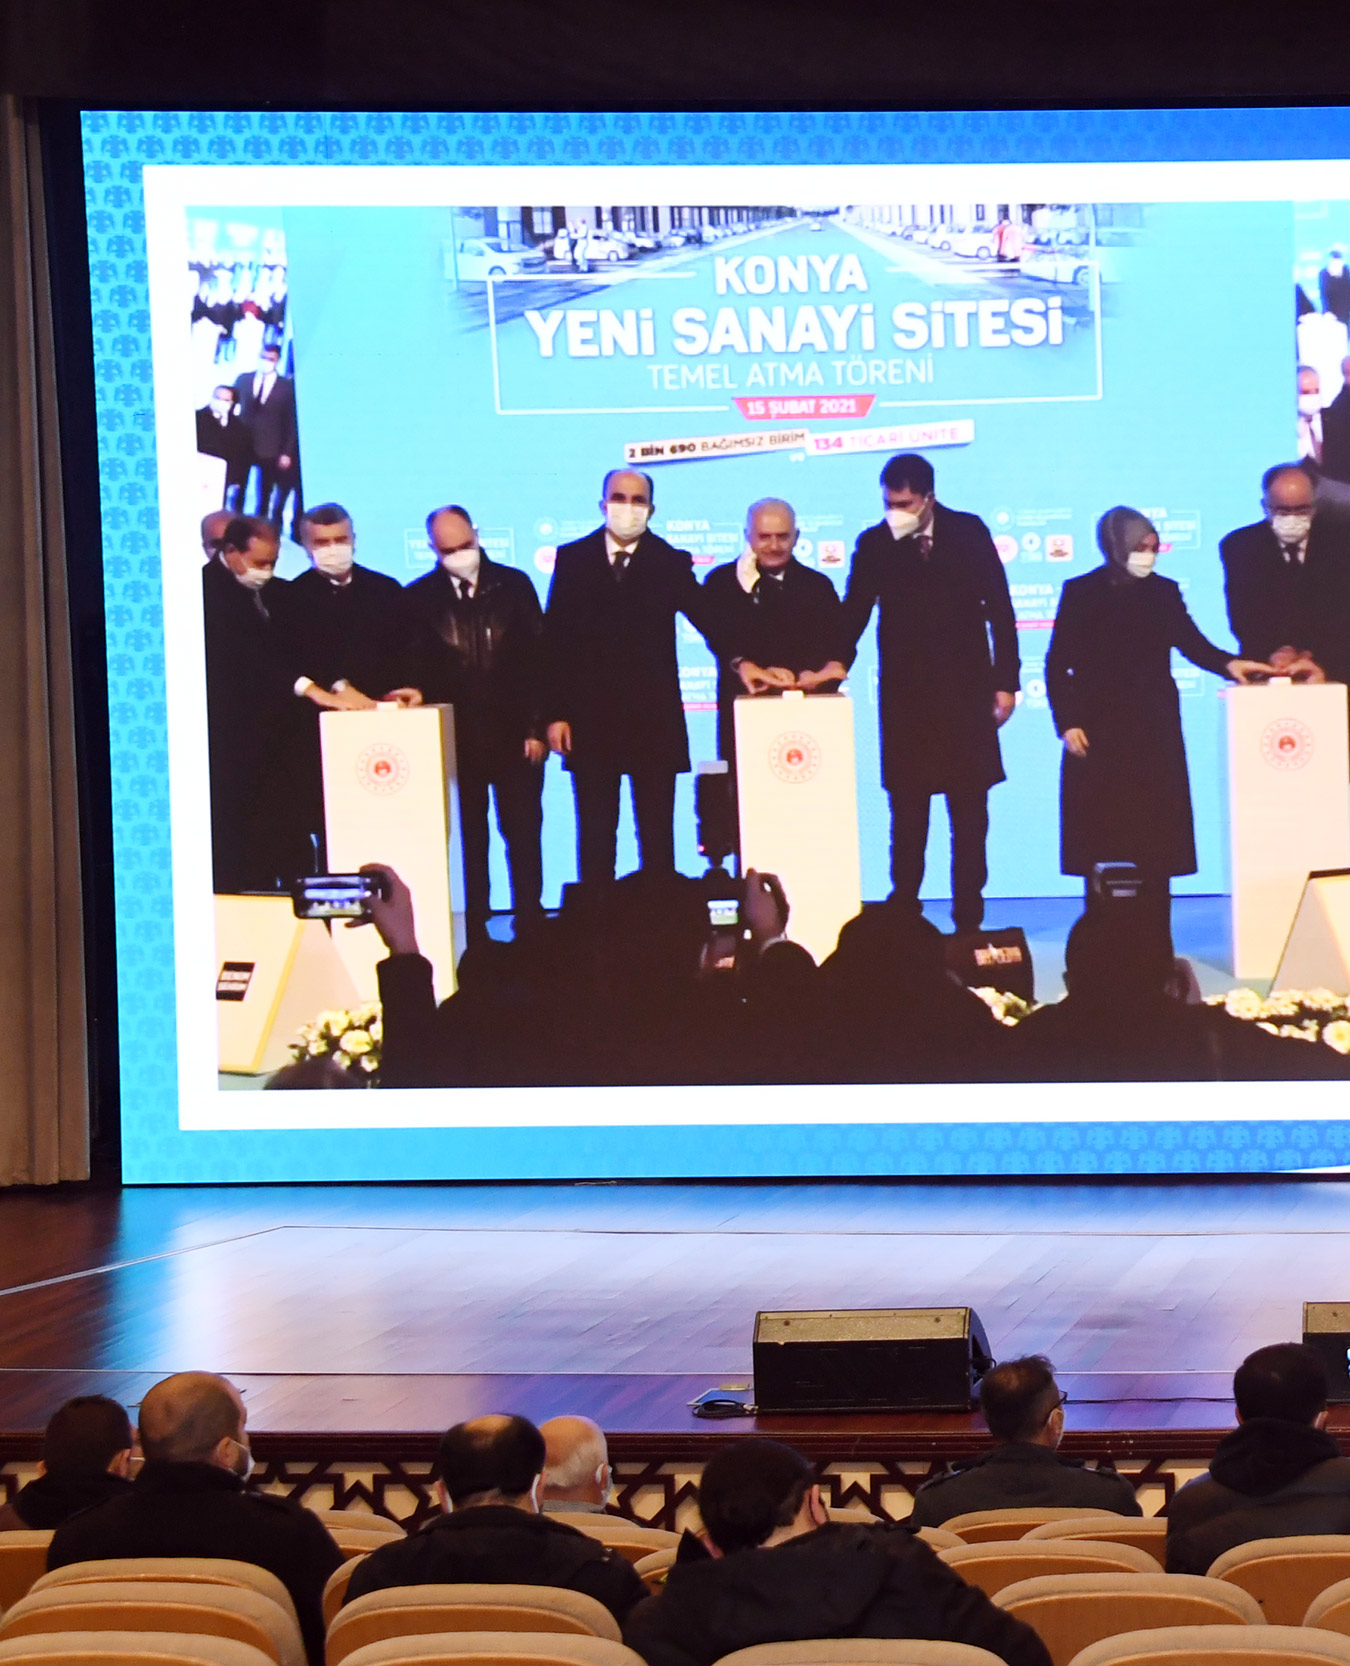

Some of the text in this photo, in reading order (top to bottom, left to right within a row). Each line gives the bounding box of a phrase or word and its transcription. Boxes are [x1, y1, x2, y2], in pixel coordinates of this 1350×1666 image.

[714, 254, 868, 296] KONYA
[647, 352, 934, 391] TEMEL ATMA TÖRENİ
[747, 398, 857, 419] 15 ŞUBAT 2021
[814, 437, 843, 451] 134
